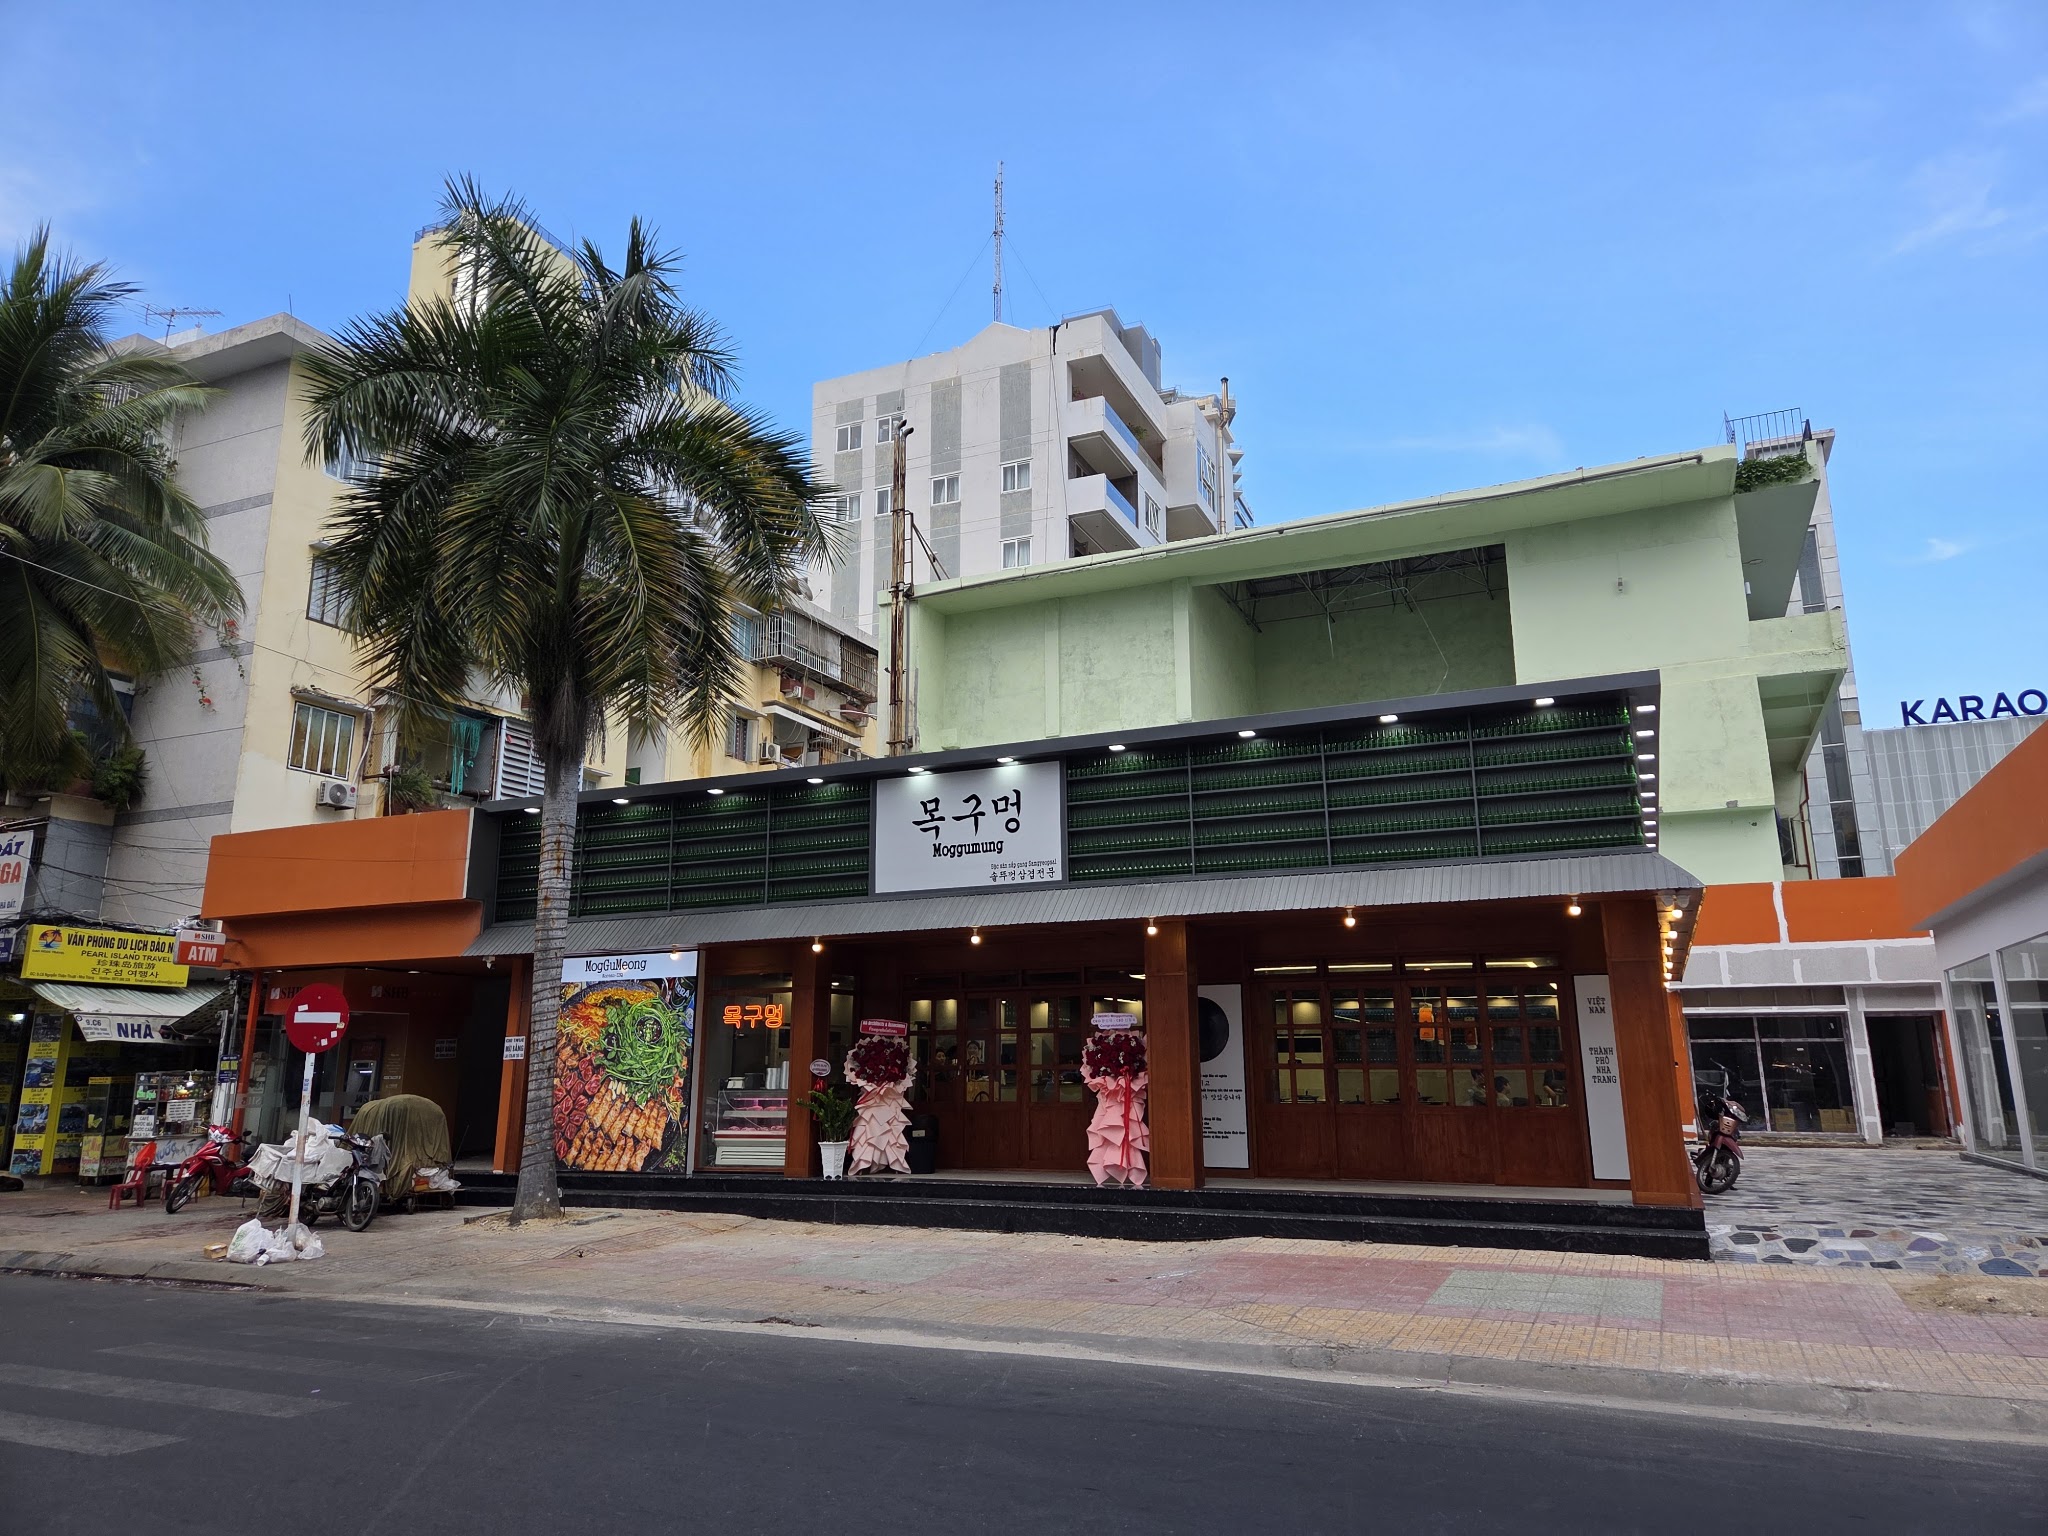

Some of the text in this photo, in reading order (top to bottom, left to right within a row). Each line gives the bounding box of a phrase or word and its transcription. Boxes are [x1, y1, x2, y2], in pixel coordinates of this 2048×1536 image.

[912, 789, 1022, 840] 목구멍
[0, 835, 24, 856] ẤT
[933, 840, 1004, 858] Moggumung
[117, 937, 129, 949] DU
[81, 950, 172, 963] PEARL ISLAND TRAVEL
[188, 946, 217, 962] ATM
[91, 967, 159, 978] 진주섬 여행사
[585, 959, 647, 973] MogGuMeong
[723, 1003, 784, 1029] 목구멍
[117, 1020, 154, 1039] NHÀ
[1589, 1046, 1613, 1055] THÀNH
[1596, 1066, 1611, 1074] NHA
[1592, 1076, 1617, 1084] TRANG
